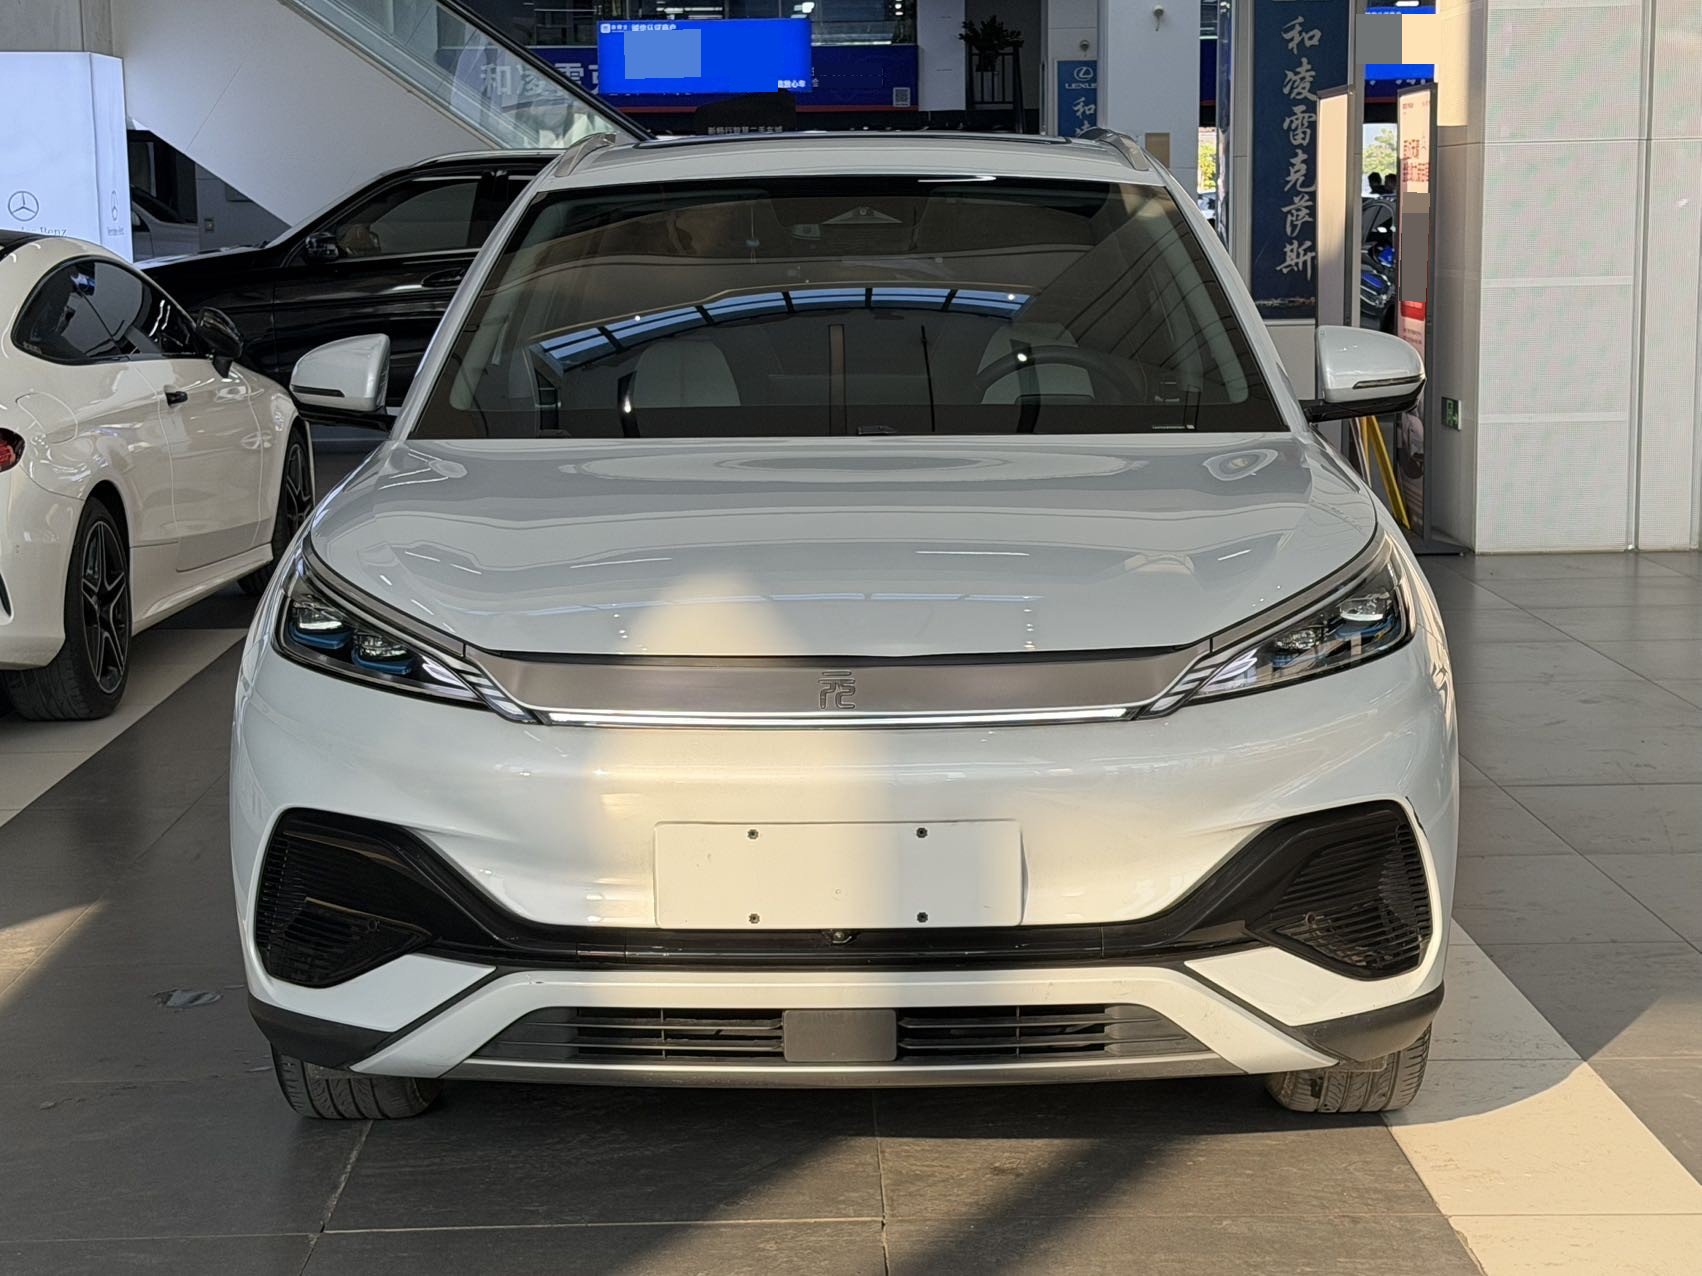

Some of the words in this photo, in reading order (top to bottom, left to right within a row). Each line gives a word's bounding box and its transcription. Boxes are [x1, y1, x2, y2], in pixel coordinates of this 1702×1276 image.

[1276, 15, 1322, 281] 和凌雷克萨斯
